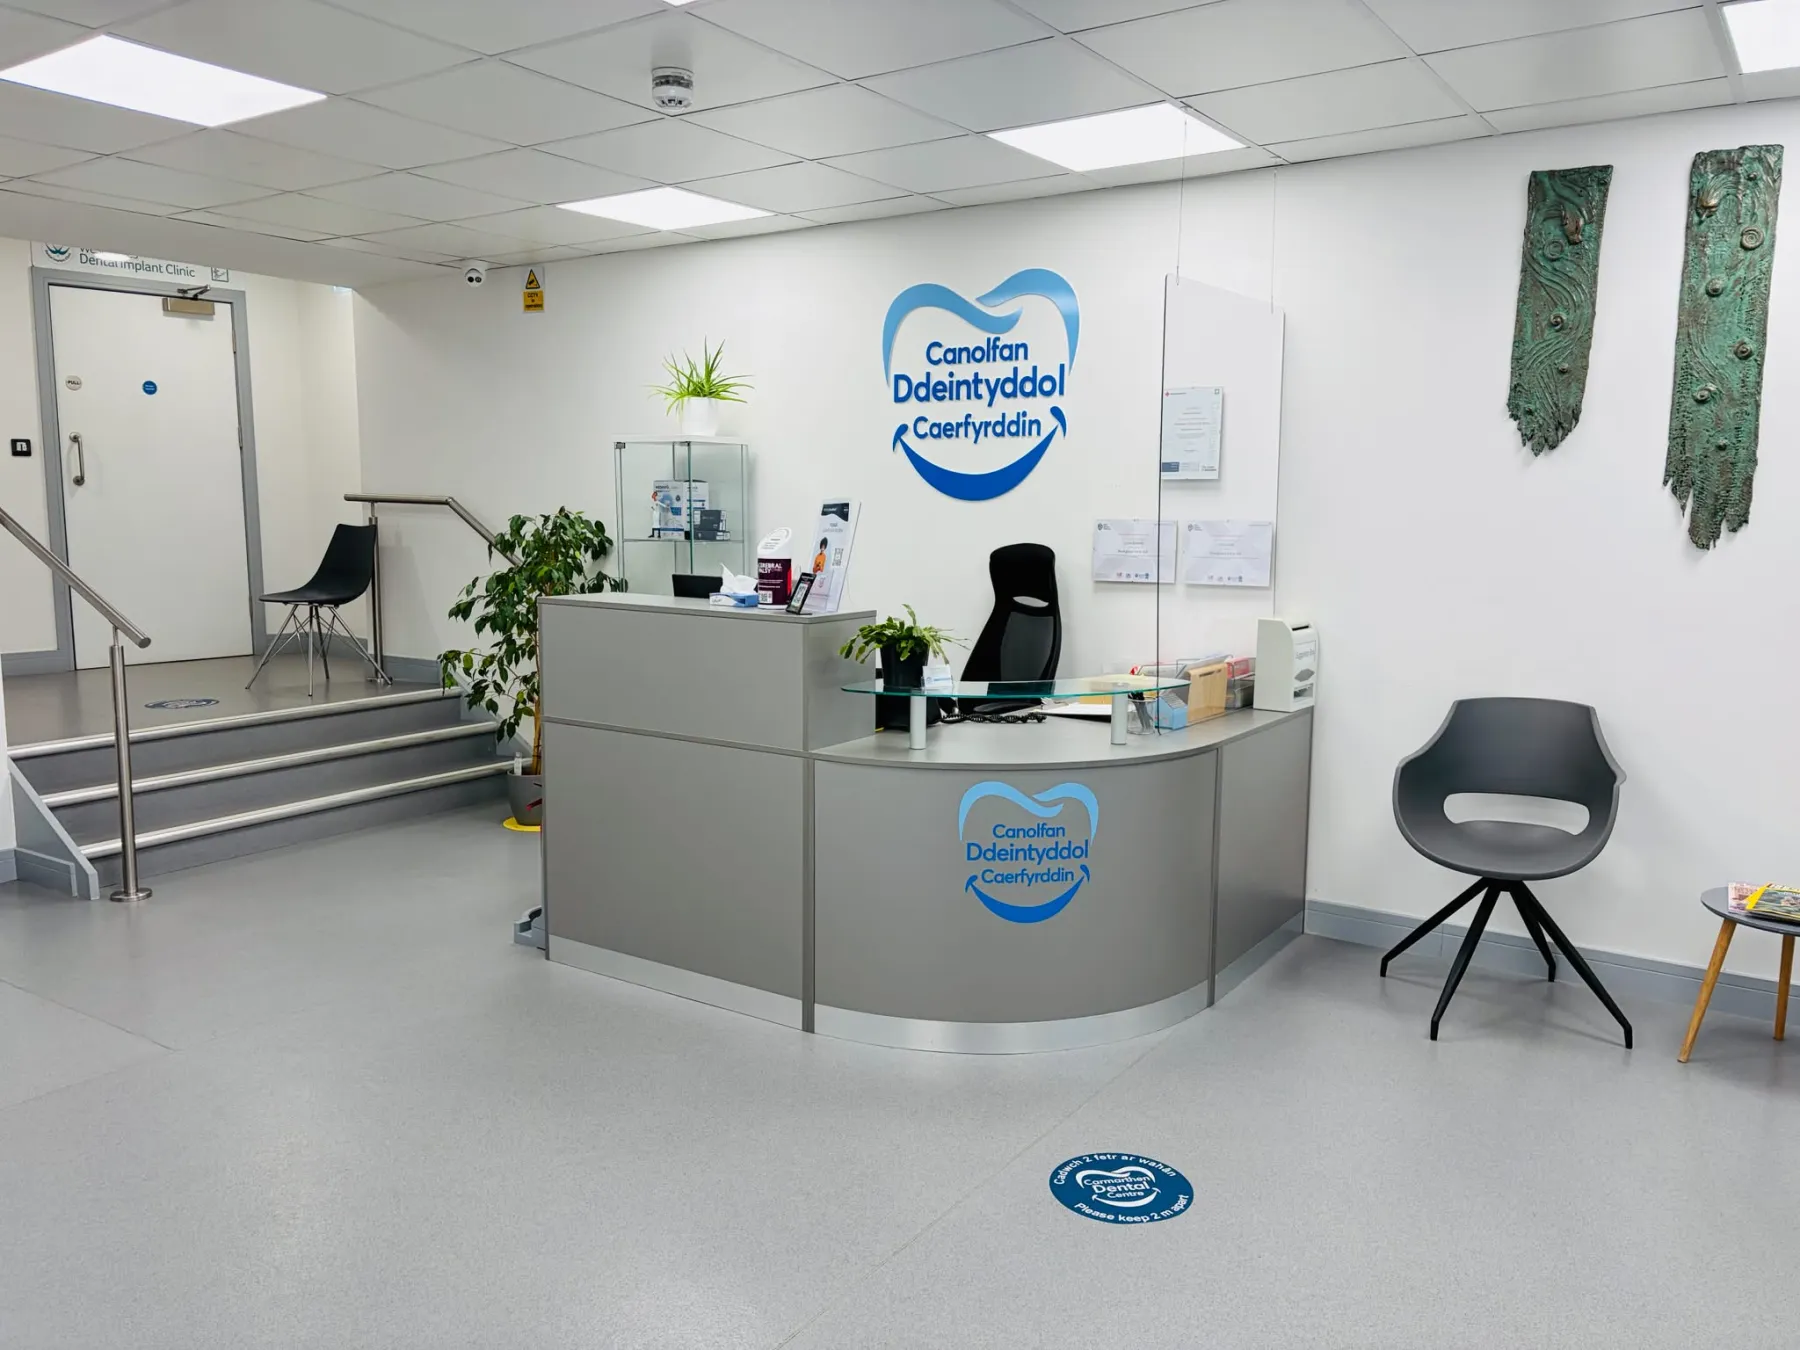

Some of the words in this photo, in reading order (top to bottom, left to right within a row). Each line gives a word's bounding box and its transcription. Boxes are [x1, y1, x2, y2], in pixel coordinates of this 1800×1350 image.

[79, 253, 119, 268] Dental
[165, 264, 196, 278] Clinic
[925, 336, 1029, 366] Canolfan
[893, 363, 1066, 408] Ddeintyddol
[913, 410, 1042, 445] Caerfyrddin
[992, 822, 1066, 839] Canolfan
[966, 839, 1089, 866] Ddeintyddol
[981, 868, 1074, 887] Caerfyrddin
[1054, 1160, 1083, 1185] Cadwch
[1094, 1153, 1118, 1161] fetr
[1083, 1175, 1151, 1187] Carmarthen
[1092, 1181, 1151, 1194] Dental
[1107, 1191, 1145, 1199] Centre
[1075, 1202, 1115, 1220] Please
[1118, 1213, 1151, 1223] keep
[1151, 1212, 1162, 1221] 2
[1162, 1209, 1175, 1218] m
[1171, 1194, 1190, 1212] apart
